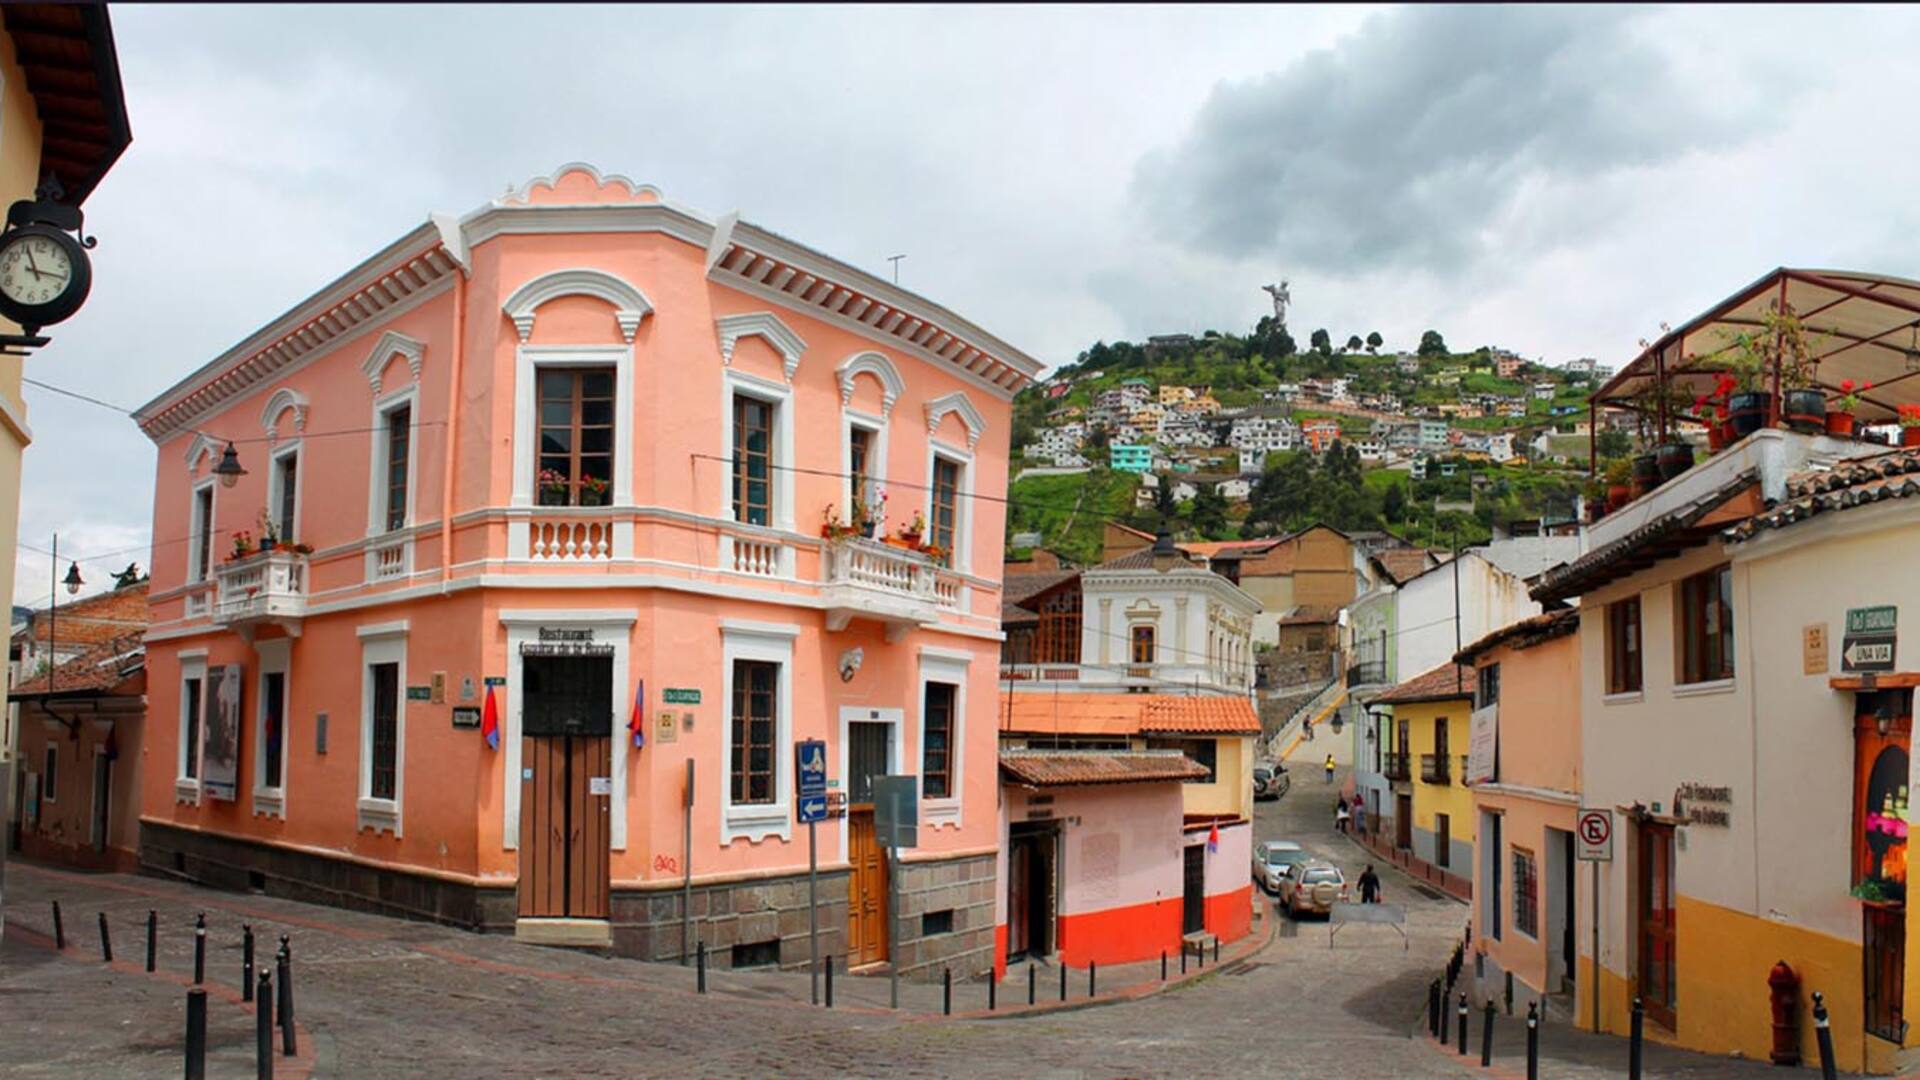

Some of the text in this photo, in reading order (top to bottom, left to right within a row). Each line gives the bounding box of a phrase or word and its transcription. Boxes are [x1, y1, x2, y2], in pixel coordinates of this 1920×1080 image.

[35, 241, 47, 253] 12
[8, 251, 20, 262] 10
[2, 263, 10, 273] 9
[58, 258, 66, 268] 2
[4, 275, 13, 286] 8
[15, 286, 23, 296] 7
[54, 282, 62, 292] 4
[27, 291, 35, 301] 6
[40, 289, 49, 300] 5
[1856, 646, 1888, 661] UNA VIA
